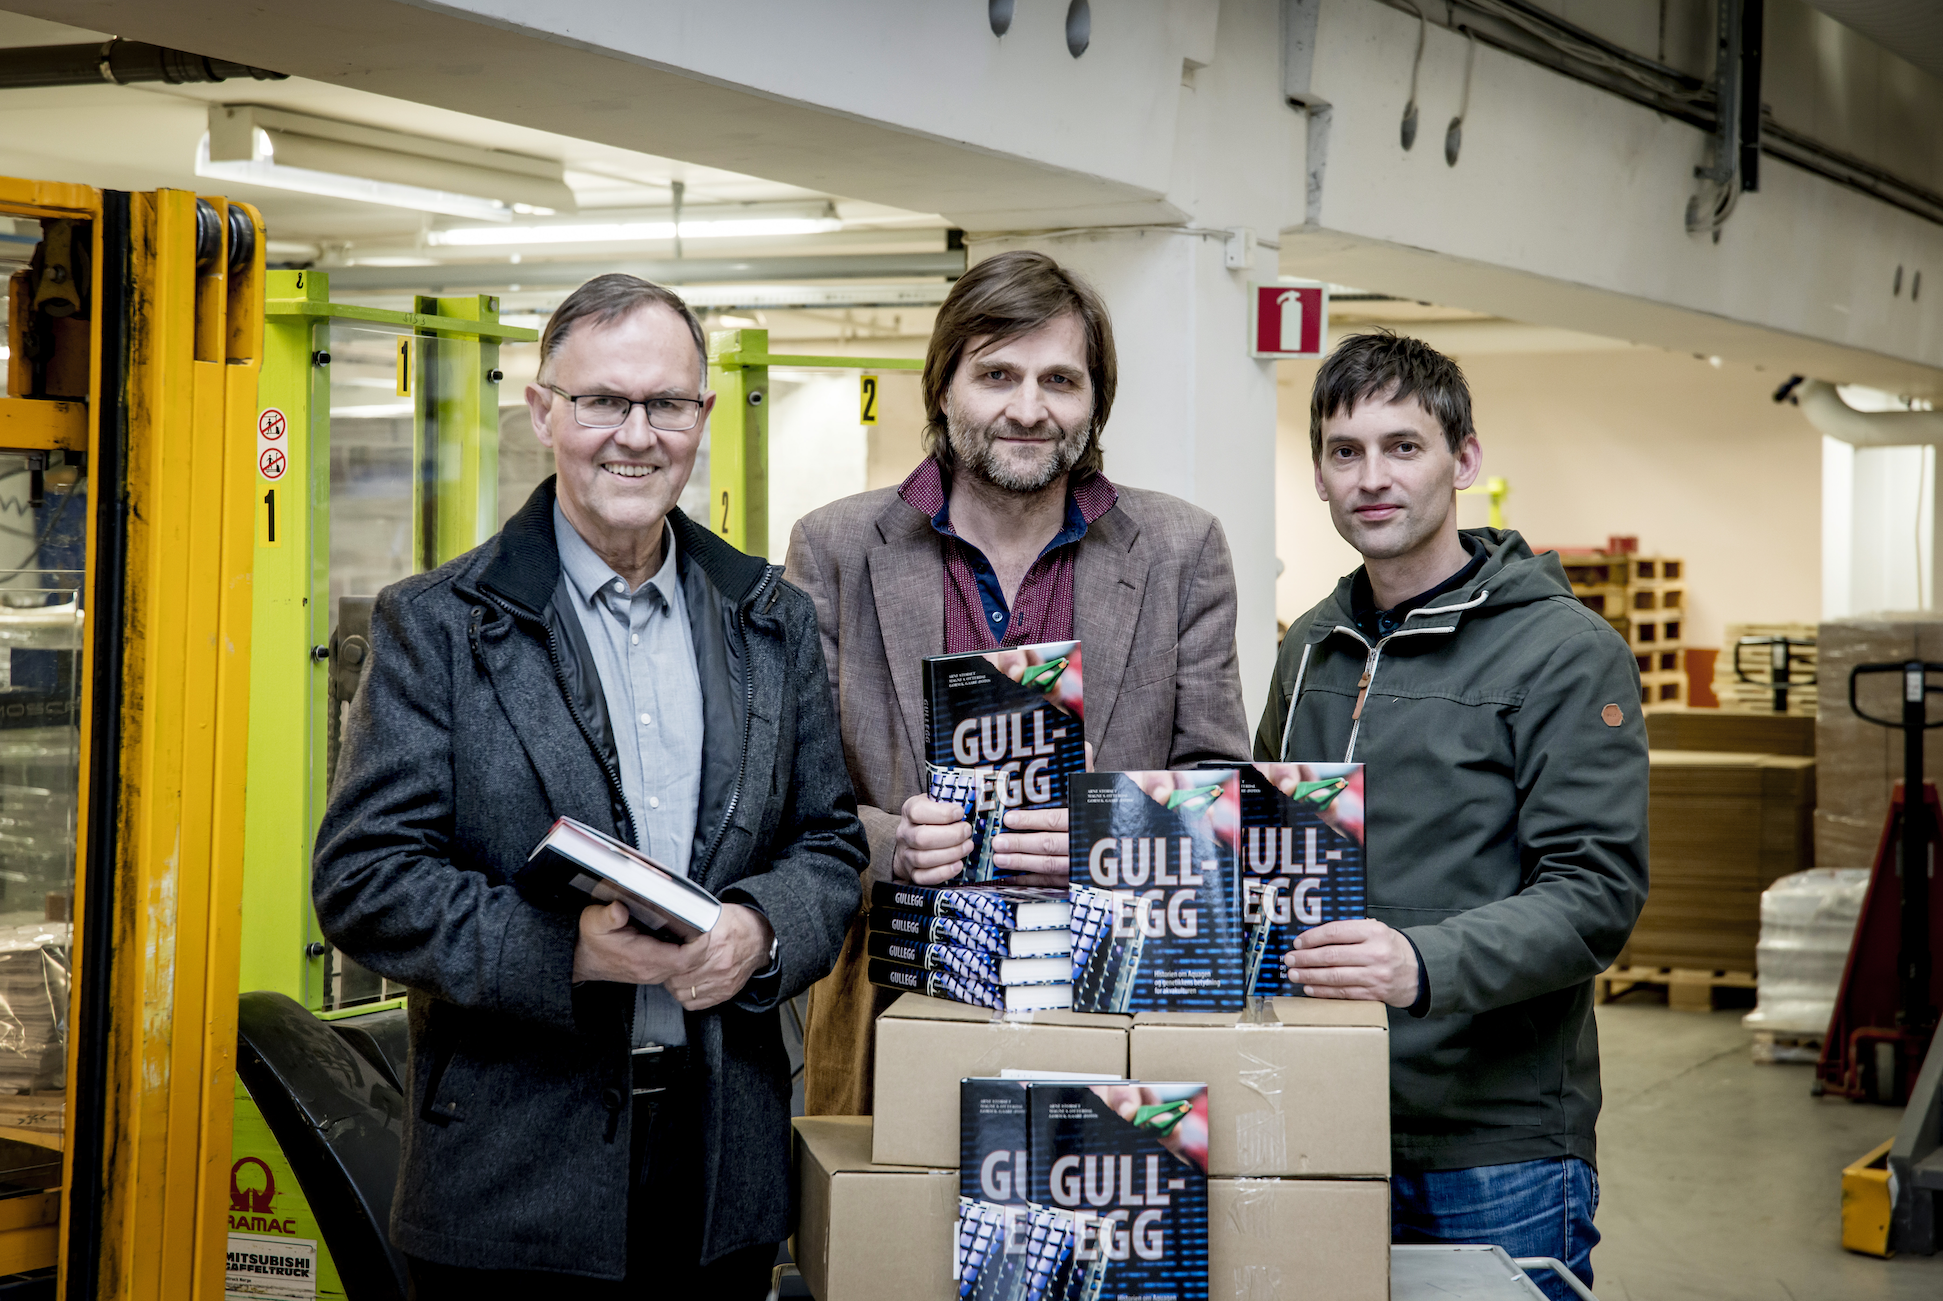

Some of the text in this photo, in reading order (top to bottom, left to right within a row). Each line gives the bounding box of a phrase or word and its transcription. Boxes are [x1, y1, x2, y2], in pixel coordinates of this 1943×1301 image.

[401, 341, 408, 392] 1
[863, 379, 875, 421] 2
[264, 489, 275, 542] 1
[721, 491, 729, 534] 2
[952, 709, 1067, 765] GULL-
[974, 757, 1051, 812] EGG
[1088, 837, 1218, 887] GULL-
[1242, 827, 1342, 874] ULL-
[895, 892, 924, 907] GULLEGG
[1112, 888, 1198, 938] EGG
[1243, 877, 1322, 924] EGG
[891, 919, 919, 934] GULLEGG
[889, 945, 915, 960] GULLEGG
[1154, 970, 1177, 978] Historien
[890, 971, 917, 987] GULLEGG
[1154, 980, 1162, 988] og
[1154, 987, 1162, 995] for
[1050, 1154, 1185, 1206] GULL-
[1073, 1209, 1163, 1261] EGG
[227, 1252, 310, 1269] MITSUBISHI
